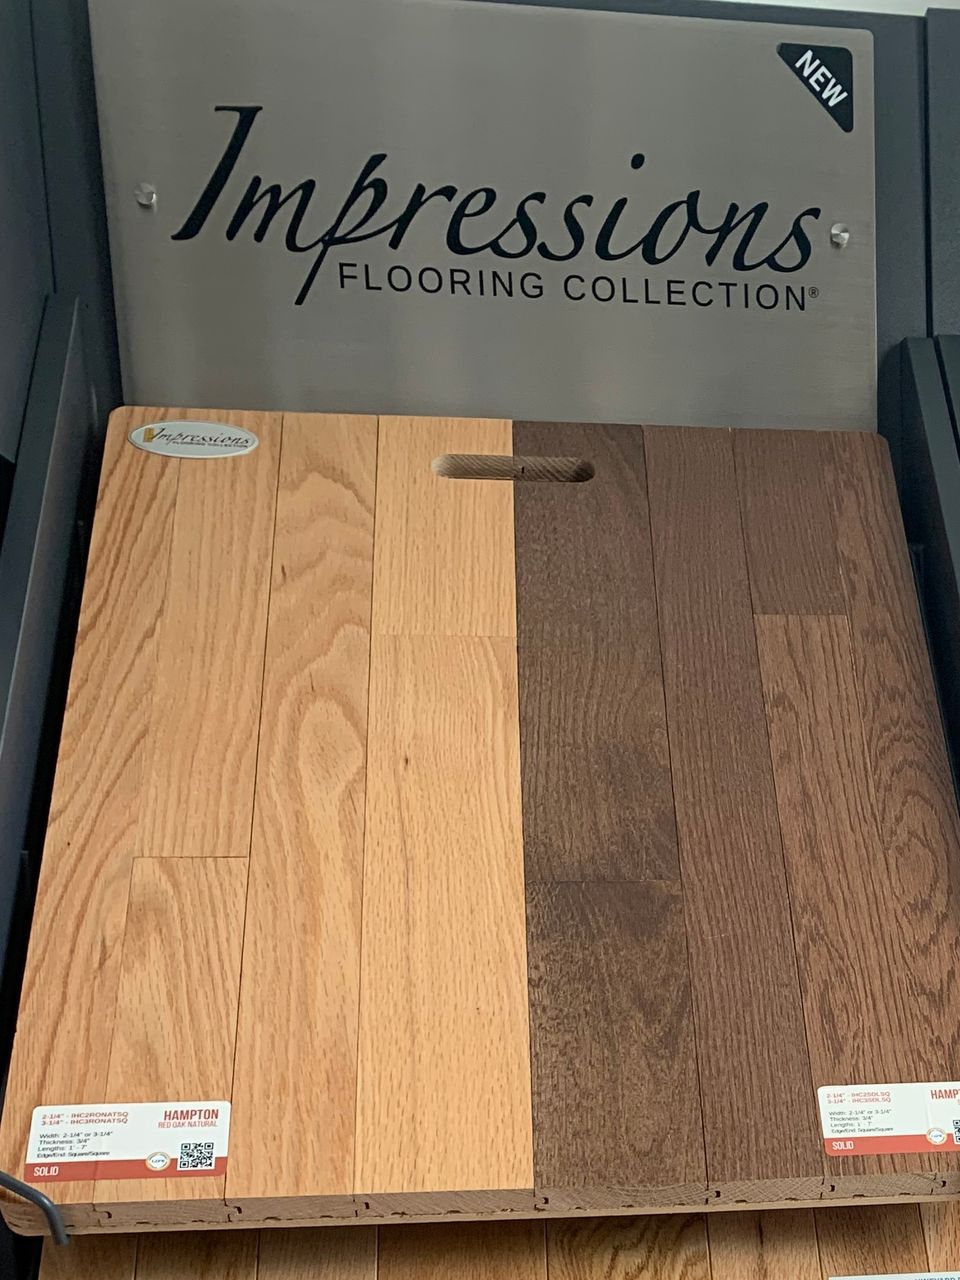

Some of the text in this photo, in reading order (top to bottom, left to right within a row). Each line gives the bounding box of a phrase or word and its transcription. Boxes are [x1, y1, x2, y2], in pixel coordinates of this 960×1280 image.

[793, 49, 848, 108] NEW
[171, 105, 822, 305] Impressions
[338, 262, 545, 300] FLOORING
[150, 427, 249, 446] Impressions
[163, 1109, 219, 1120] HAMPTON
[832, 1141, 853, 1150] SOLID
[33, 1166, 59, 1176] SOLID
